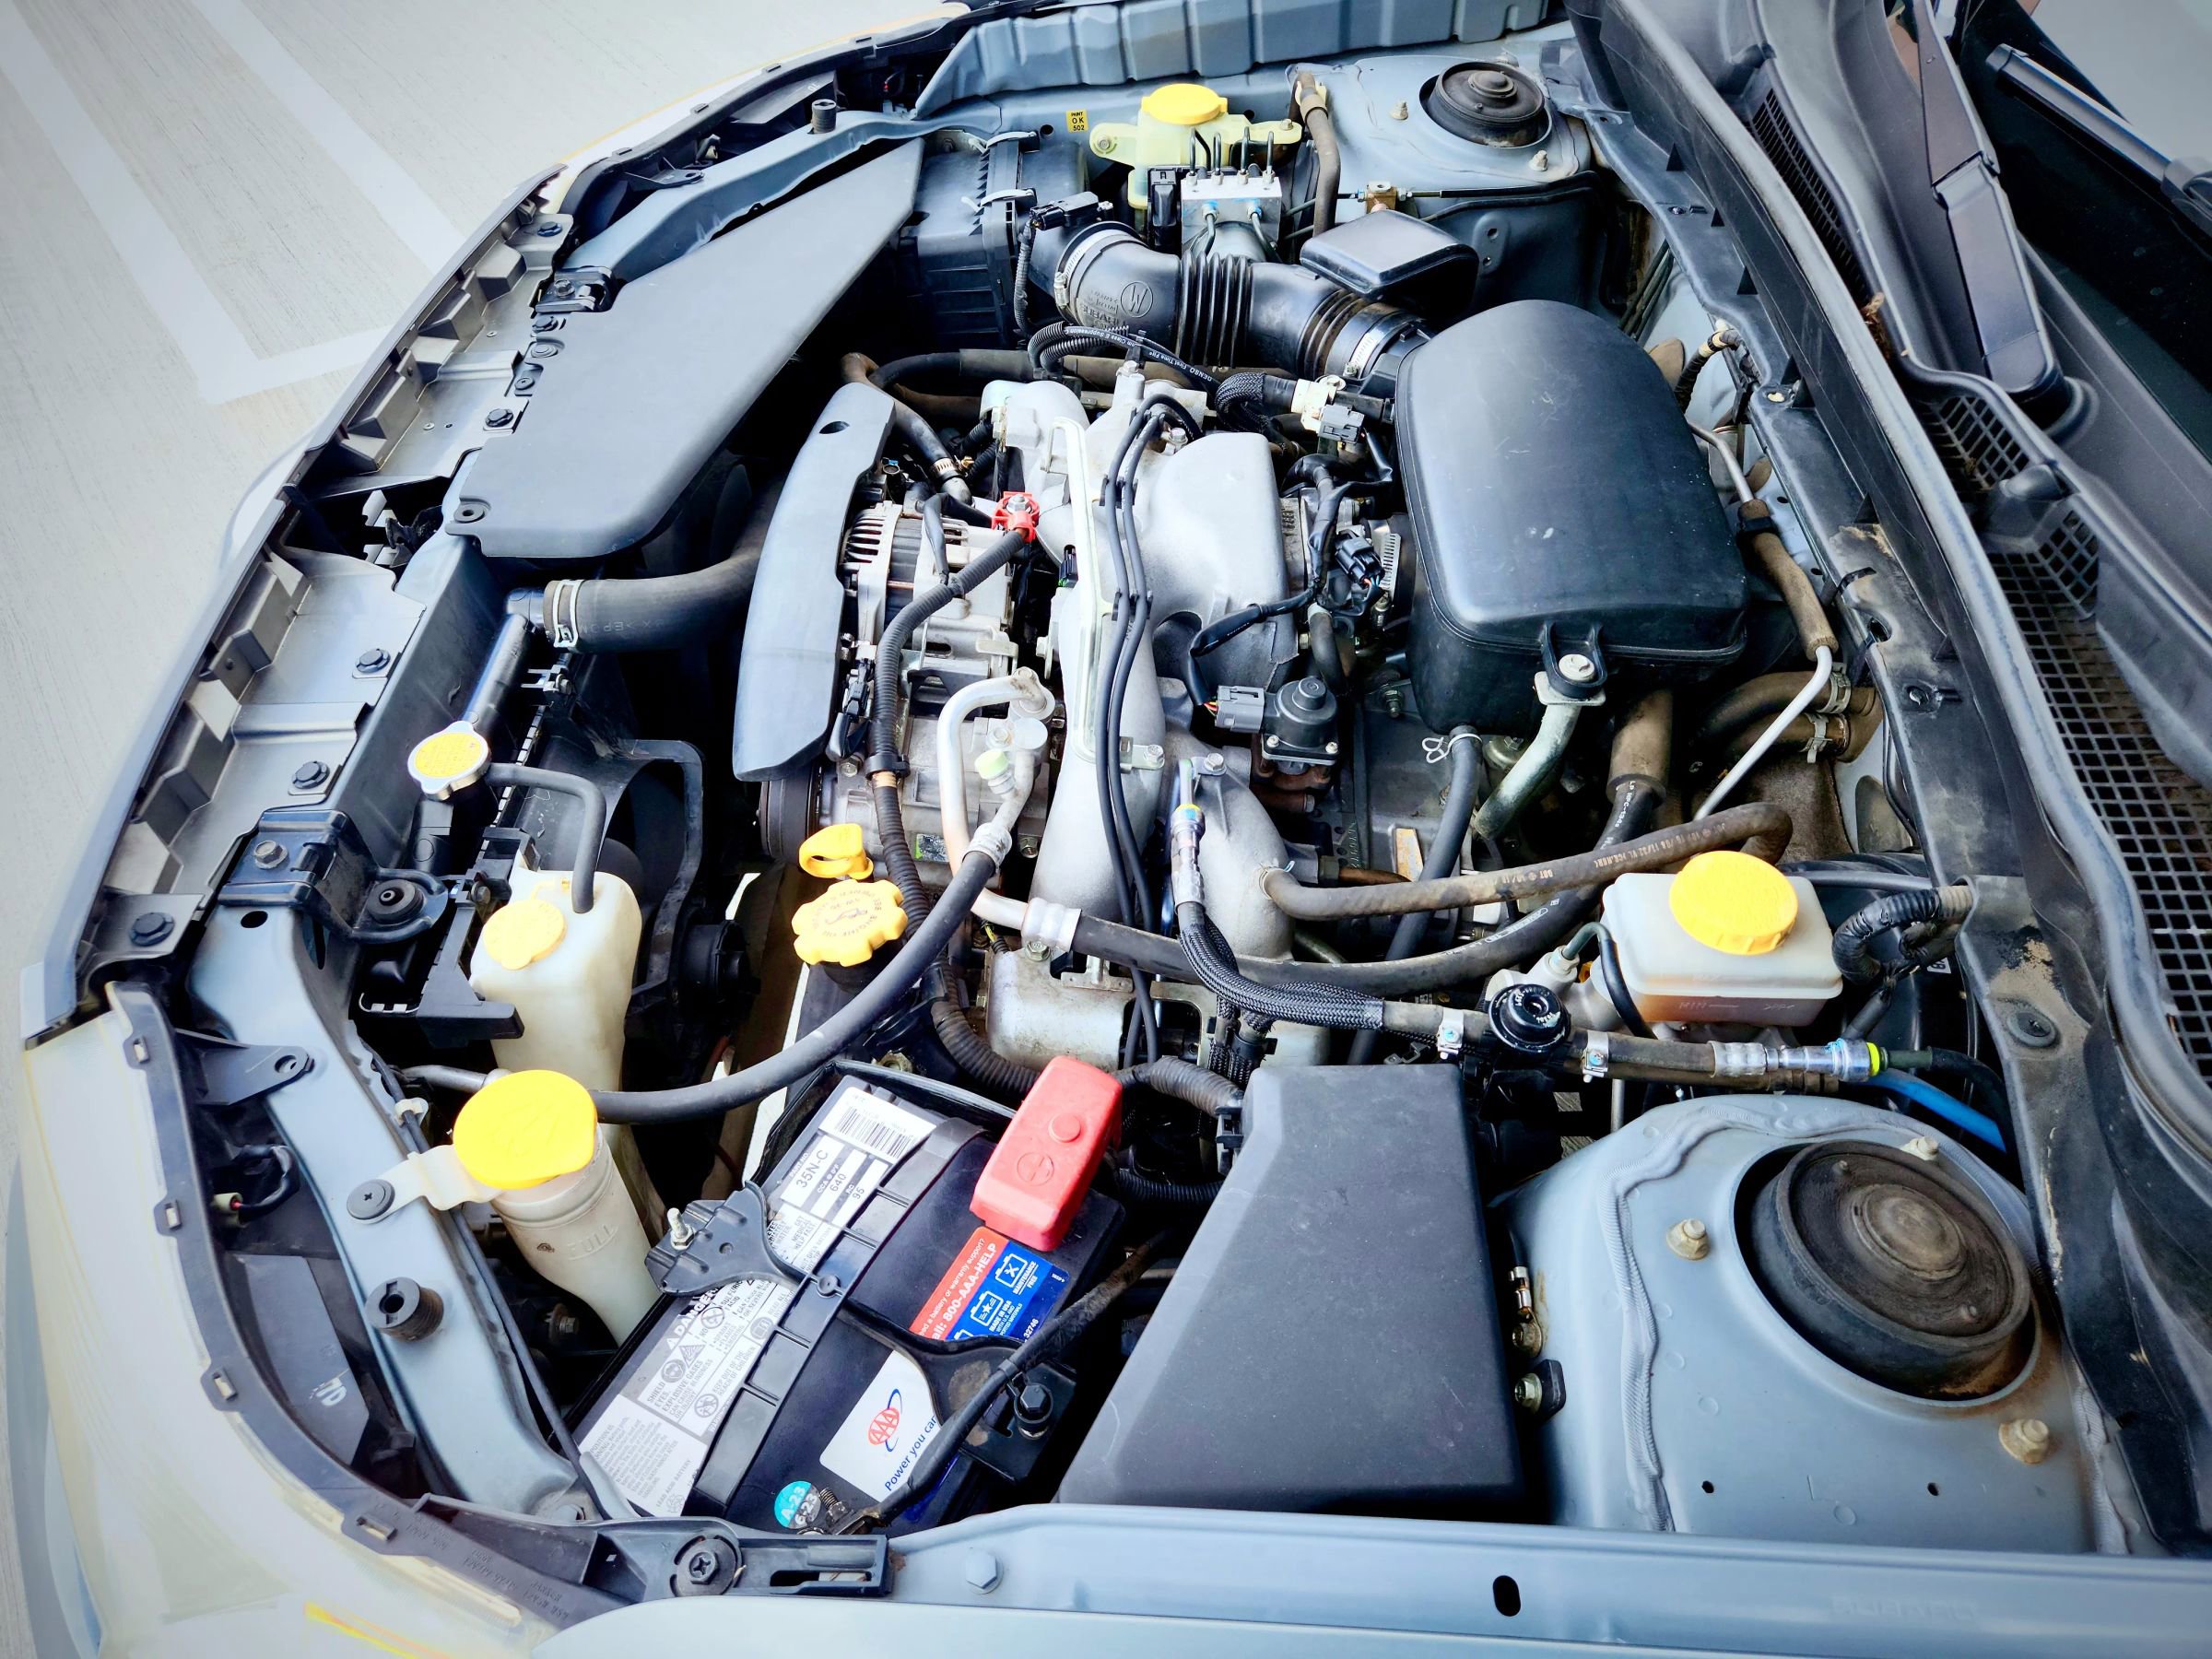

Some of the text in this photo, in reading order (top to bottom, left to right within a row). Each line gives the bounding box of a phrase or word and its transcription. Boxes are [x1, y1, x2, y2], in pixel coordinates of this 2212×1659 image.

[1187, 366, 1213, 382] DENSO
[794, 1147, 830, 1190] 35N-C
[816, 1178, 830, 1194] CCA
[828, 1171, 848, 1193] 640
[844, 1182, 855, 1194] RC
[851, 1185, 865, 1200] 95
[964, 1236, 987, 1265] support?
[947, 1262, 971, 1290] warranty
[1011, 1259, 1038, 1295] MAINTENANCE
[1026, 1274, 1039, 1289] FREE
[929, 1241, 1000, 1341] all: 800-AAA-HELP
[943, 1288, 953, 1298] or
[928, 1294, 948, 1319] battery
[987, 1298, 1013, 1332] MADE IN USA
[916, 1321, 930, 1337] eed
[998, 1320, 1012, 1336] PORTED
[1021, 1316, 1040, 1339] 32746
[645, 1379, 666, 1405] SHIELD
[661, 1358, 704, 1413] EXPLOSIVE GASES
[667, 1356, 714, 1417] CAN CAUSE BLINDNESS
[882, 1453, 913, 1491] Power
[908, 1433, 927, 1458] you
[780, 1485, 807, 1522] A-23
